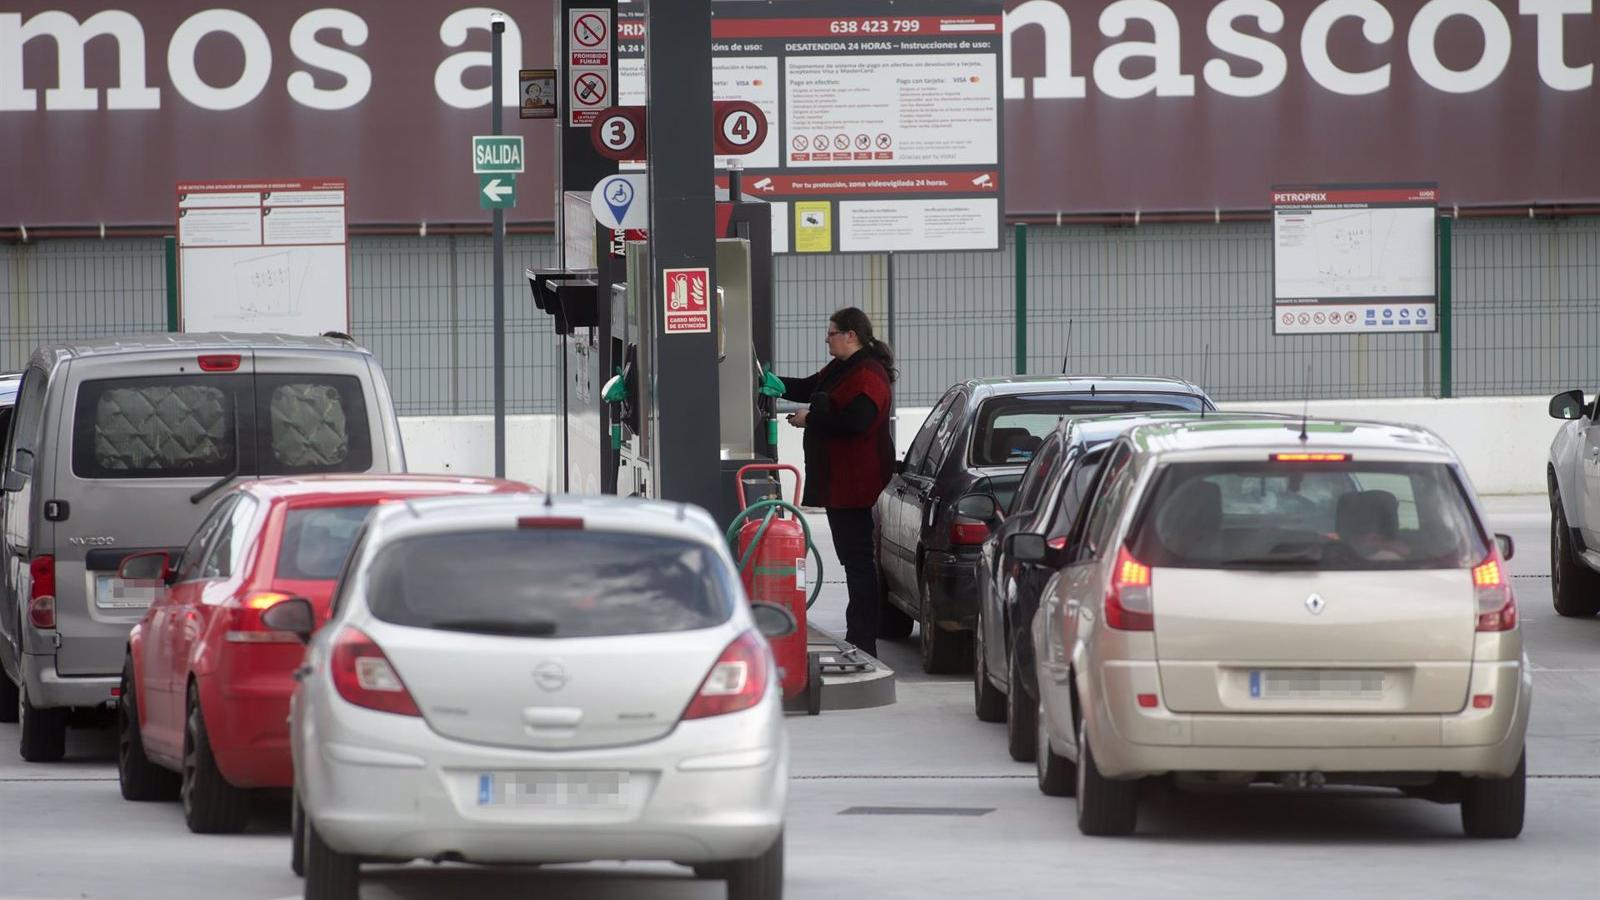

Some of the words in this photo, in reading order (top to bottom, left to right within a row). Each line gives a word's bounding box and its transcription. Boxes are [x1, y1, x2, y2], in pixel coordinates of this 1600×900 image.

[830, 21, 857, 33] 638
[861, 21, 888, 33] 423
[893, 20, 920, 32] 799
[731, 43, 742, 51] de
[785, 43, 846, 51] DESATENDIDA
[848, 42, 859, 50] 24
[861, 42, 892, 50] HORAS
[901, 41, 957, 49] Instrucciones
[959, 41, 970, 49] de
[434, 7, 523, 109] a
[732, 115, 750, 139] 4
[610, 121, 627, 145] 3
[476, 144, 521, 165] SALIDA
[812, 181, 848, 189] protección,
[867, 180, 914, 188] videovigilada
[1274, 193, 1327, 201] PETROPRIX
[69, 536, 115, 545] NV200
